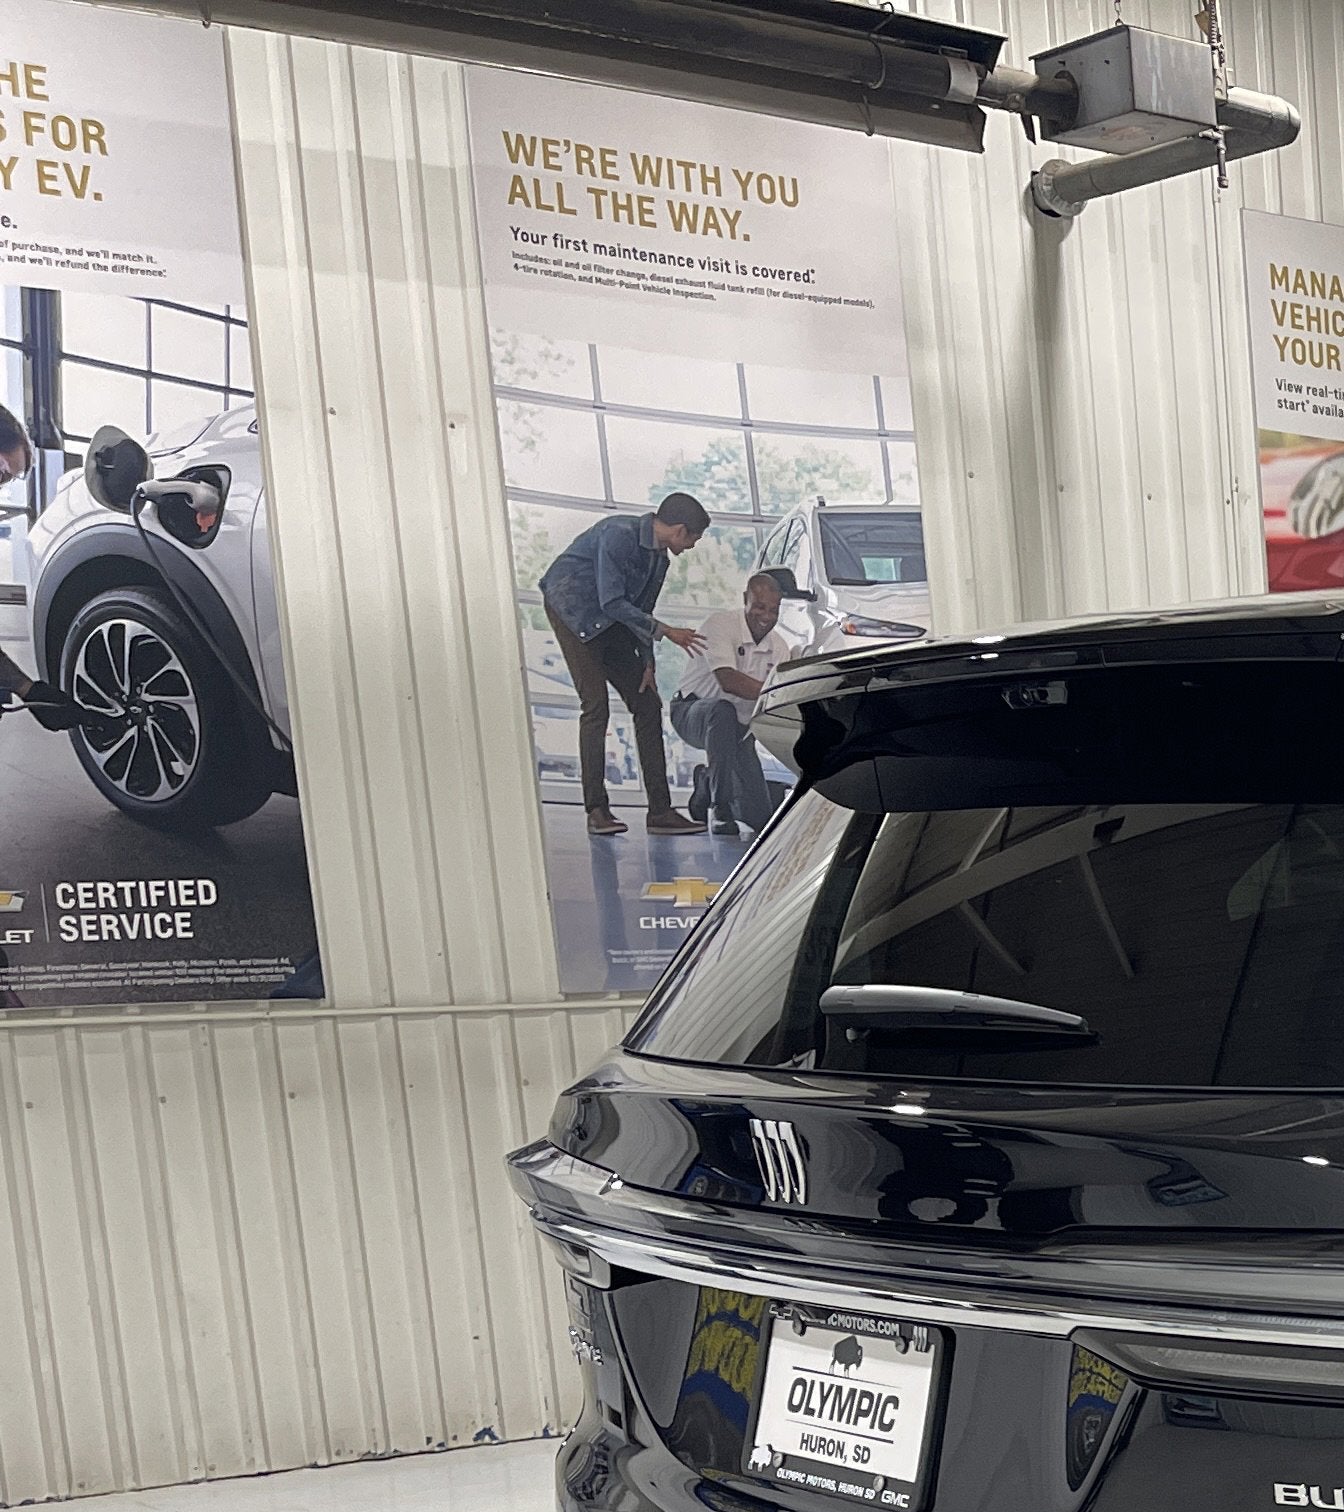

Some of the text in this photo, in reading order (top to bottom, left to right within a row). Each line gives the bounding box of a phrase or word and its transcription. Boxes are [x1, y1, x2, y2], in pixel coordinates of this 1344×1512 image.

[23, 111, 108, 156] FOR
[36, 159, 103, 201] EV.
[502, 130, 800, 208] WE'RE WITH YOU
[507, 174, 751, 242] ALL THE WAY.
[7, 254, 26, 263] and
[55, 259, 89, 270] refund
[92, 263, 108, 272] the
[12, 242, 62, 255] purchase,
[65, 248, 84, 257] and
[112, 252, 143, 263] match
[509, 226, 547, 246] Your
[552, 233, 588, 253] first
[593, 243, 694, 269] maintenance
[698, 256, 731, 273] visit
[735, 260, 748, 276] is
[512, 250, 550, 265] Includes:
[565, 261, 580, 270] and
[582, 263, 592, 272] oil
[594, 264, 615, 275] filter
[616, 269, 648, 281] change,
[650, 272, 673, 284] diesel
[707, 281, 725, 291] fluid
[513, 262, 538, 274] 4-tire
[540, 268, 576, 282] rotation,
[578, 275, 593, 284] and
[595, 276, 640, 291] Multi-Point
[642, 284, 671, 295] Vehicle
[1273, 334, 1342, 372] YOUR
[1275, 378, 1303, 394] View
[55, 879, 218, 910] CERTIFIED
[59, 911, 195, 943] SERVICE
[787, 1377, 899, 1433] OLYMPIC
[800, 1432, 871, 1464] HURON, SD
[776, 1468, 910, 1508] OLYMPIC MOTORS, HURON SD GMC
